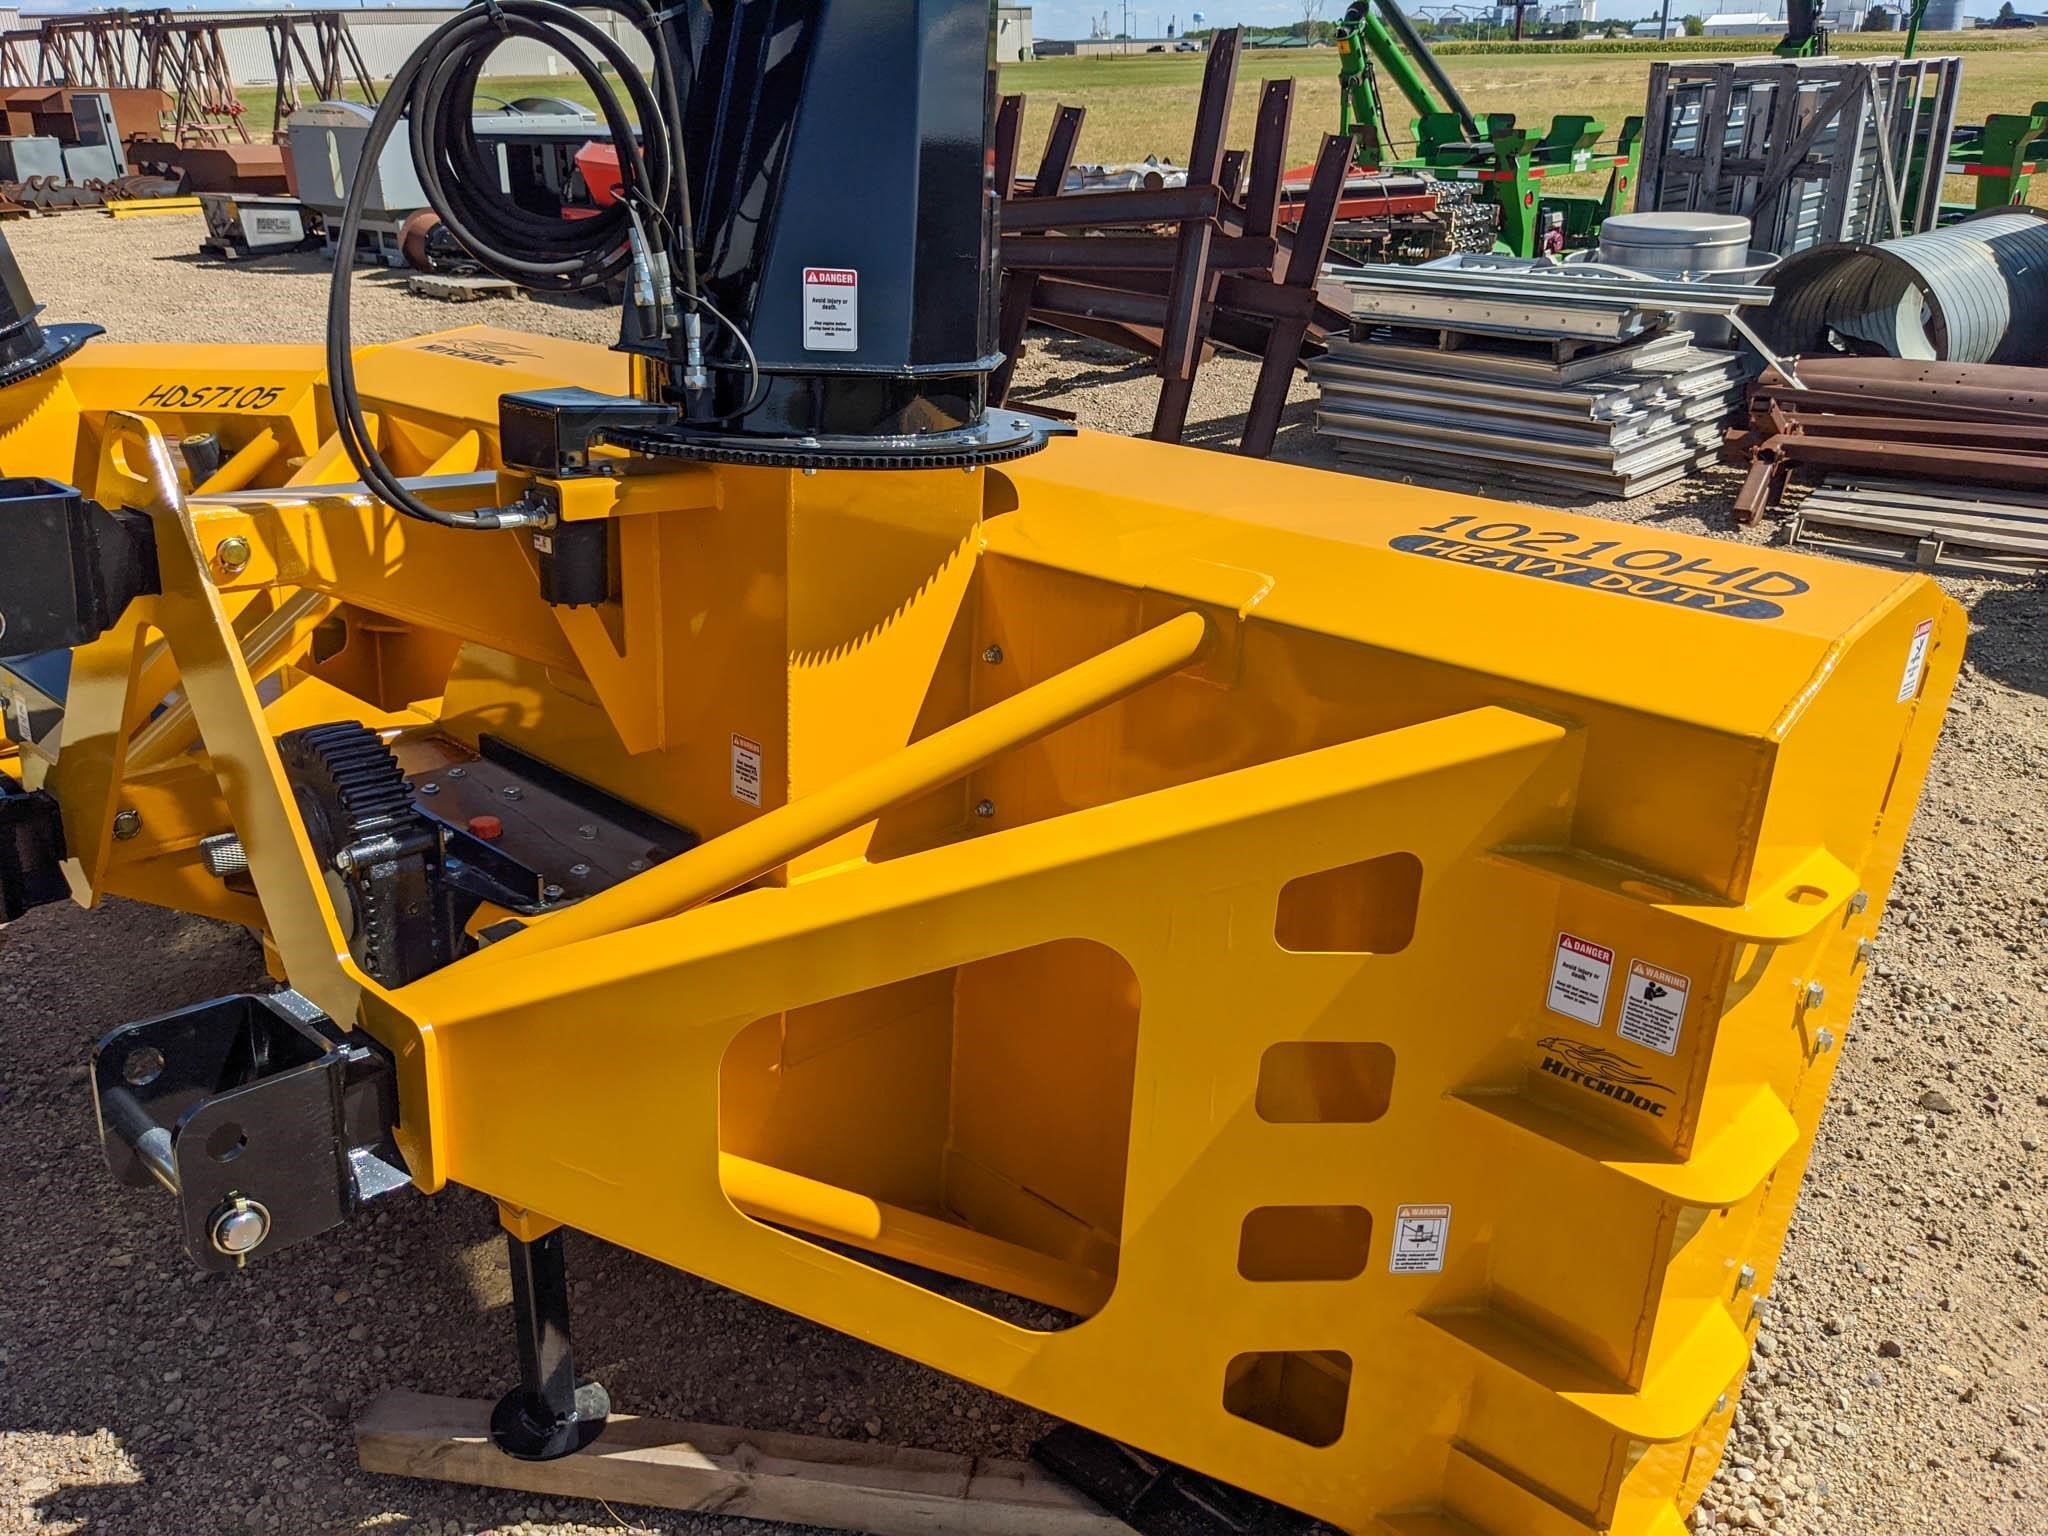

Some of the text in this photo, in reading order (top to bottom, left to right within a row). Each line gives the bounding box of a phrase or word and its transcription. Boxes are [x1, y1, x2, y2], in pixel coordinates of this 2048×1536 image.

[819, 272, 853, 283] DANGER
[138, 384, 287, 410] HDS7105
[1418, 515, 1810, 597] 10210HD
[1414, 539, 1750, 609] HEAVY DUTY
[1574, 941, 1610, 961] DANGER
[1562, 962, 1576, 971] Avoid
[1577, 967, 1592, 978] injury
[1571, 972, 1587, 981] death.
[1646, 966, 1686, 987] WARNING
[1411, 1208, 1448, 1216] WARNING
